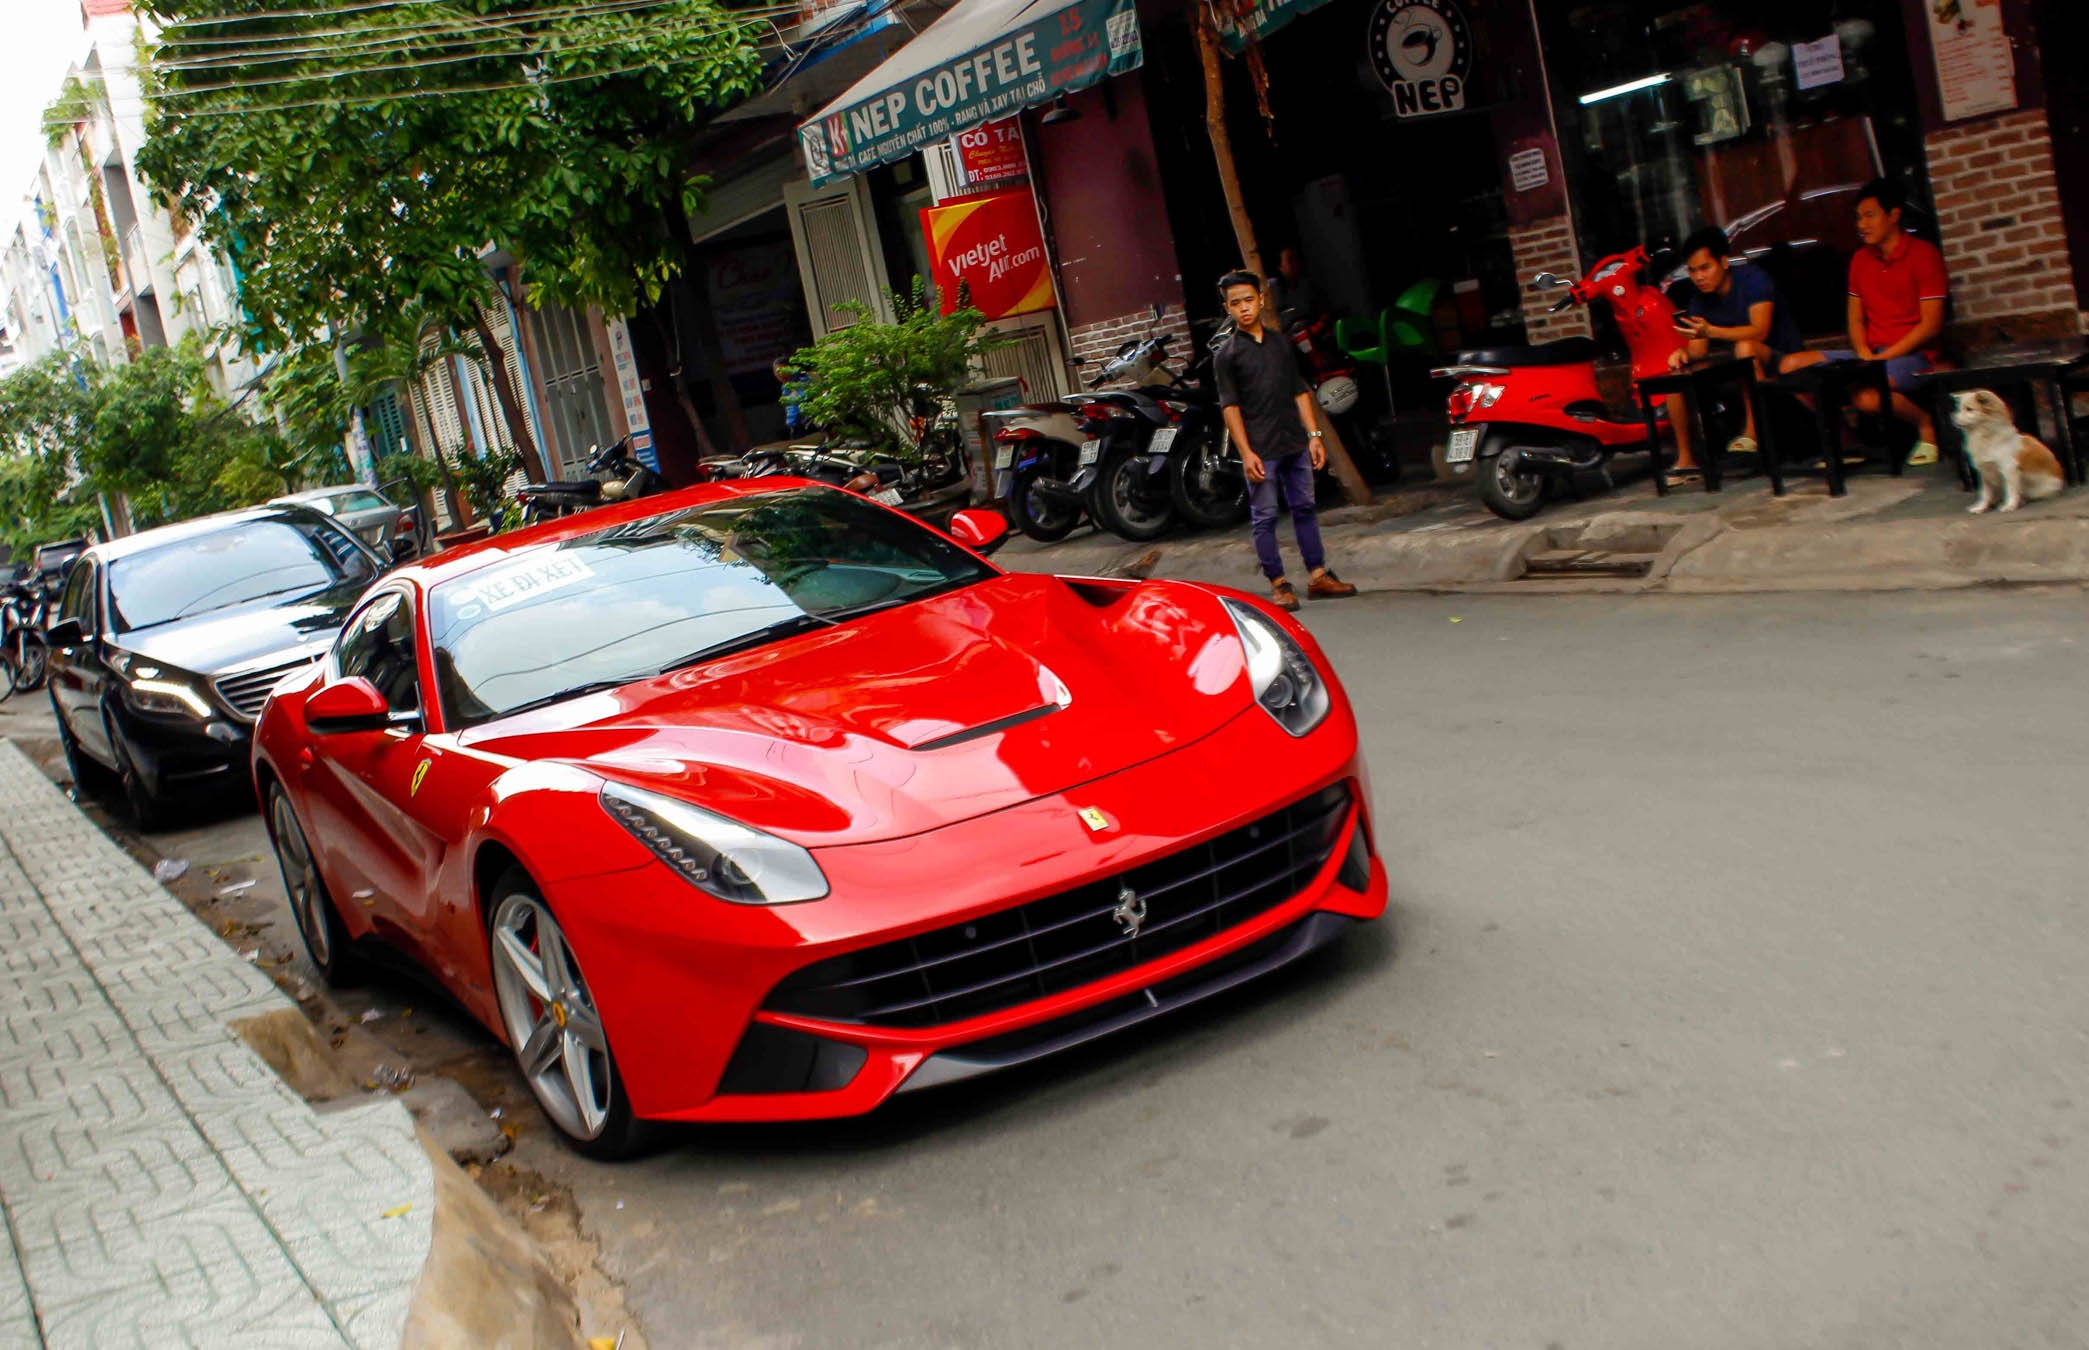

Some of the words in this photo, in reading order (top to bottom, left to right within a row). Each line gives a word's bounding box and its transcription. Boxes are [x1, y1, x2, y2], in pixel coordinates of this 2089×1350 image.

[851, 92, 906, 145] NEP
[915, 31, 1041, 117] COFFEE
[1394, 77, 1461, 115] NEP
[955, 104, 978, 126] RANG
[978, 97, 991, 117] VÀ
[991, 92, 1008, 110] XAY
[961, 127, 989, 148] CÓ
